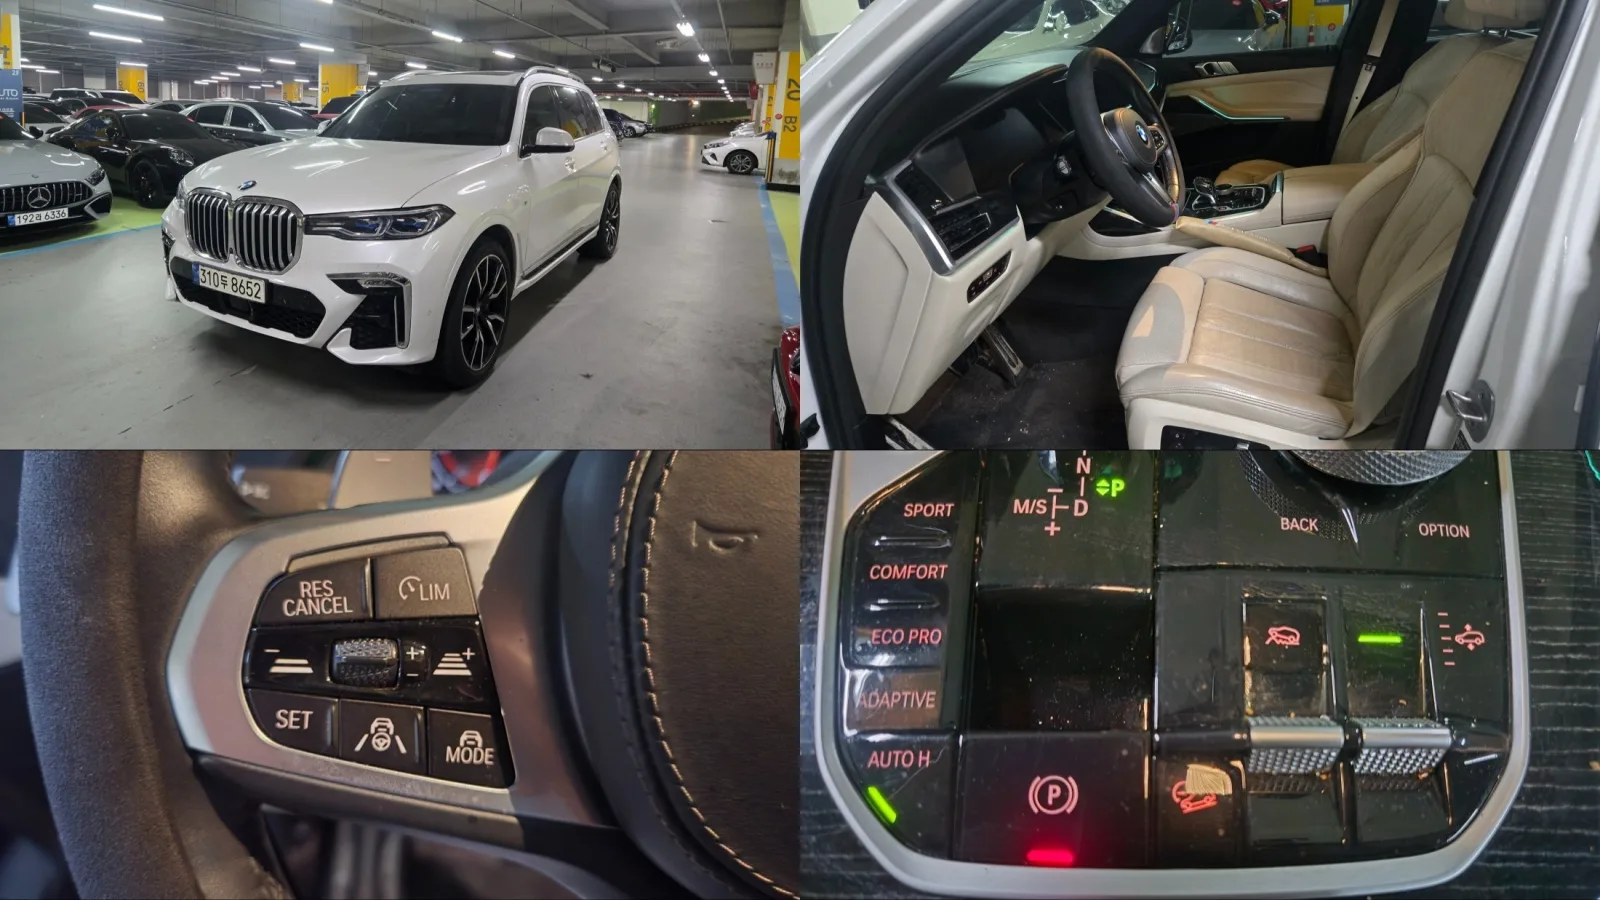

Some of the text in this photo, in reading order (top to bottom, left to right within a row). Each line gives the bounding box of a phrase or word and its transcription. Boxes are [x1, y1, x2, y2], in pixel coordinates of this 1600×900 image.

[783, 115, 798, 132] B2
[44, 209, 67, 221] 6336
[200, 268, 262, 300] 310두 8652
[1076, 457, 1091, 474] N
[1111, 478, 1125, 497] P
[903, 503, 955, 517] SPORT
[1013, 499, 1089, 517] M/S D
[1280, 517, 1319, 532] BACK
[1418, 523, 1470, 538] OPTION
[869, 564, 949, 580] COMFORT
[300, 580, 334, 598] RES
[419, 583, 450, 601] LIM
[282, 597, 353, 616] CANCEL
[871, 628, 942, 644] ECO PRO
[856, 691, 936, 708] ADAPTIVE
[275, 710, 313, 730] SET
[446, 746, 494, 765] MODE
[867, 750, 931, 768] AUTO H
